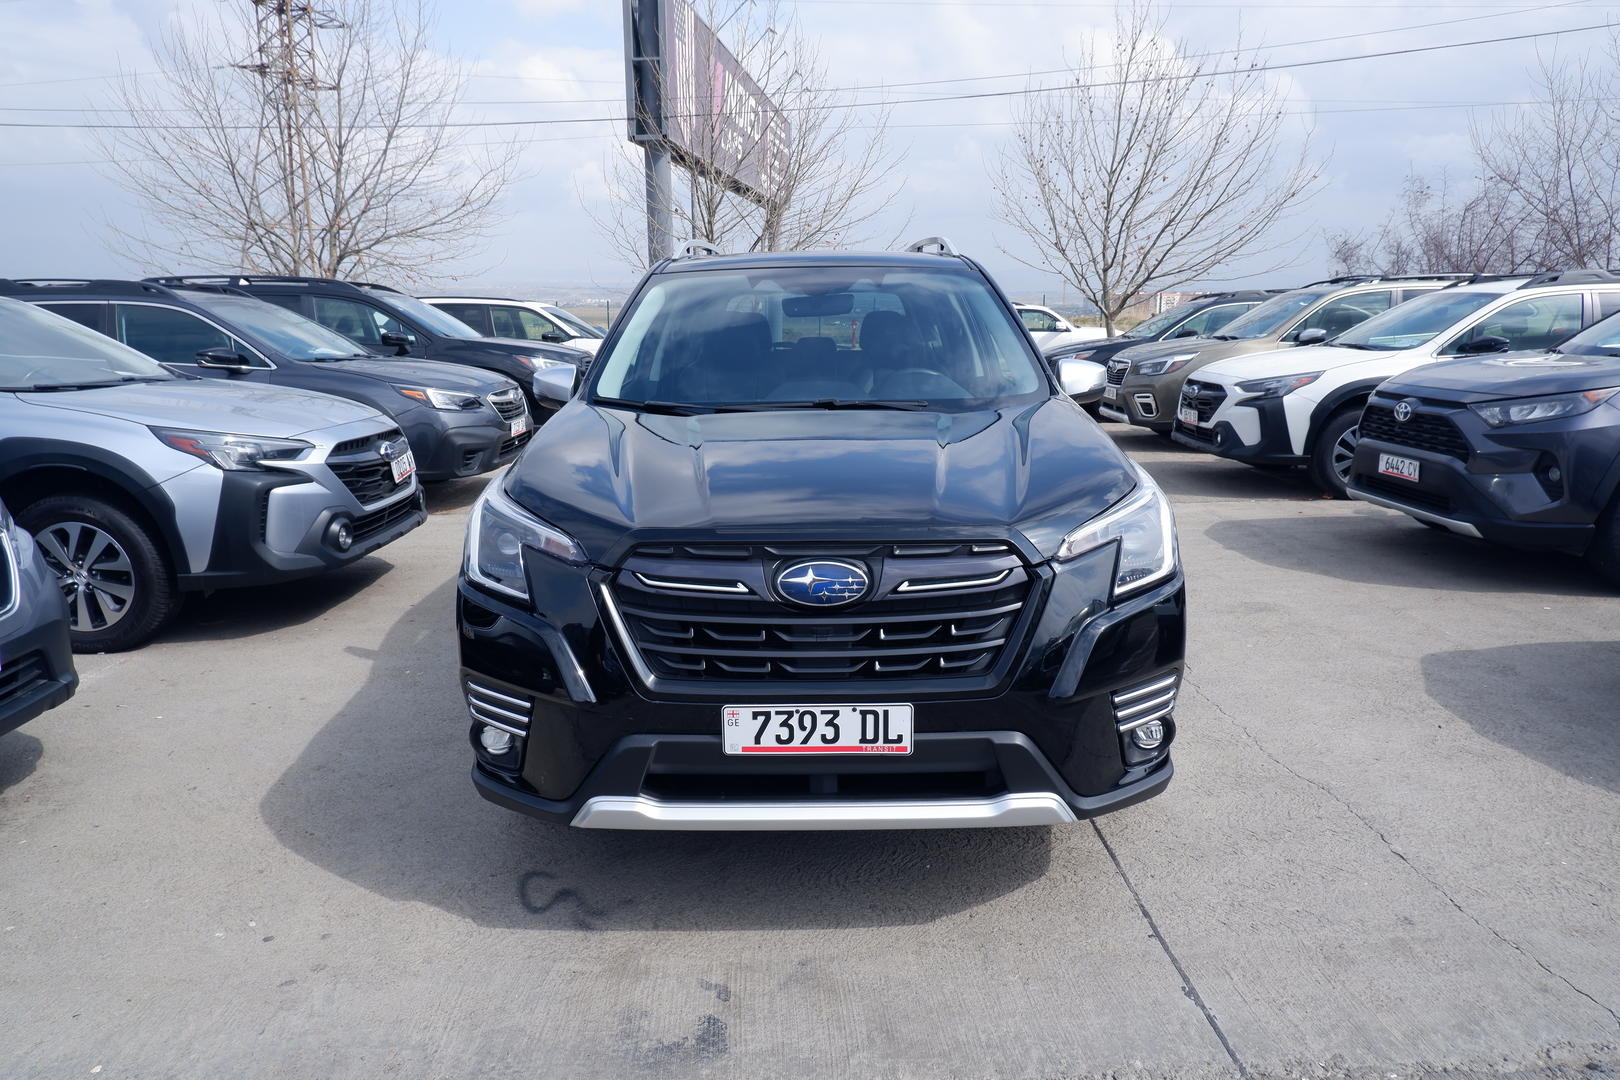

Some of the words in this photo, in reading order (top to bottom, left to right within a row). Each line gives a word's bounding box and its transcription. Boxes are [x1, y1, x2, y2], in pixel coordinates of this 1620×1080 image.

[1385, 457, 1405, 474] 6442
[1408, 462, 1417, 478] CY
[727, 718, 740, 727] GE
[752, 709, 840, 745] 7393
[859, 709, 903, 745] DL
[862, 745, 898, 753] TRANSIT
